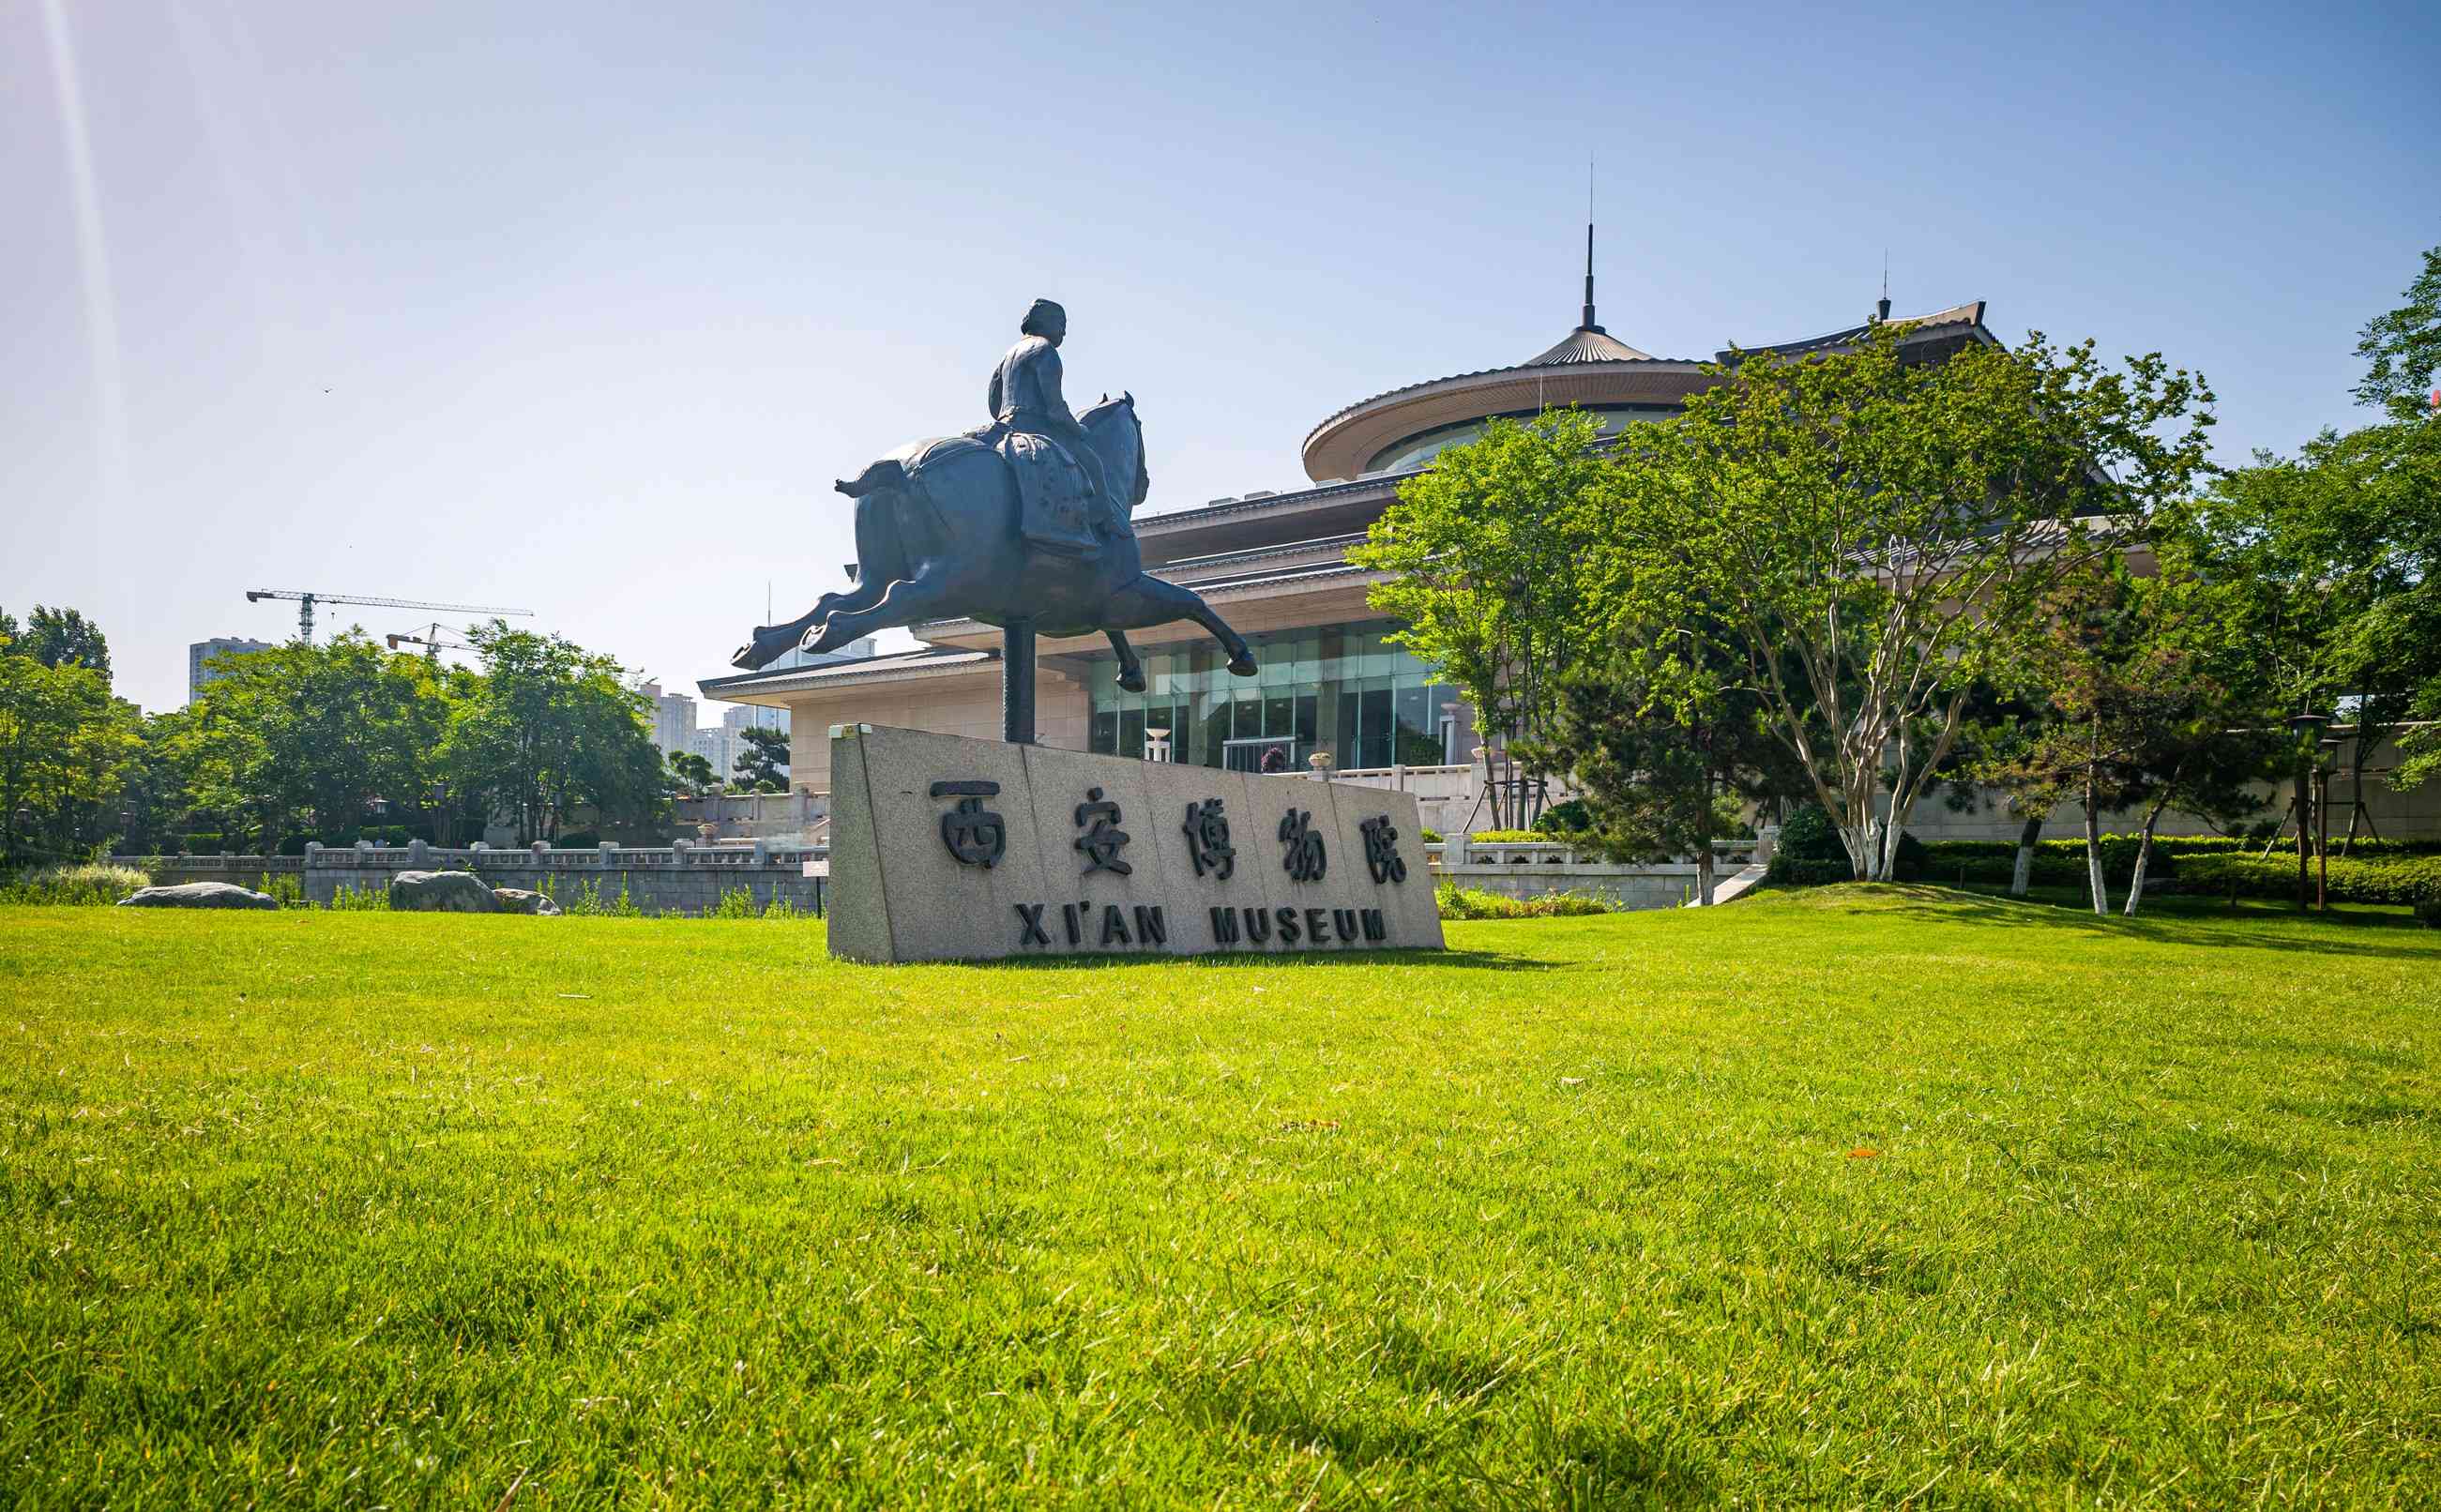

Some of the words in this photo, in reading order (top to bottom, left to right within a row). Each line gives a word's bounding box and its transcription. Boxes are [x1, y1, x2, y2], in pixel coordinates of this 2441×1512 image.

[930, 780, 1407, 884] 西安博物院
[1014, 900, 1167, 946] XI'AN
[1209, 905, 1387, 944] MUSEUM
